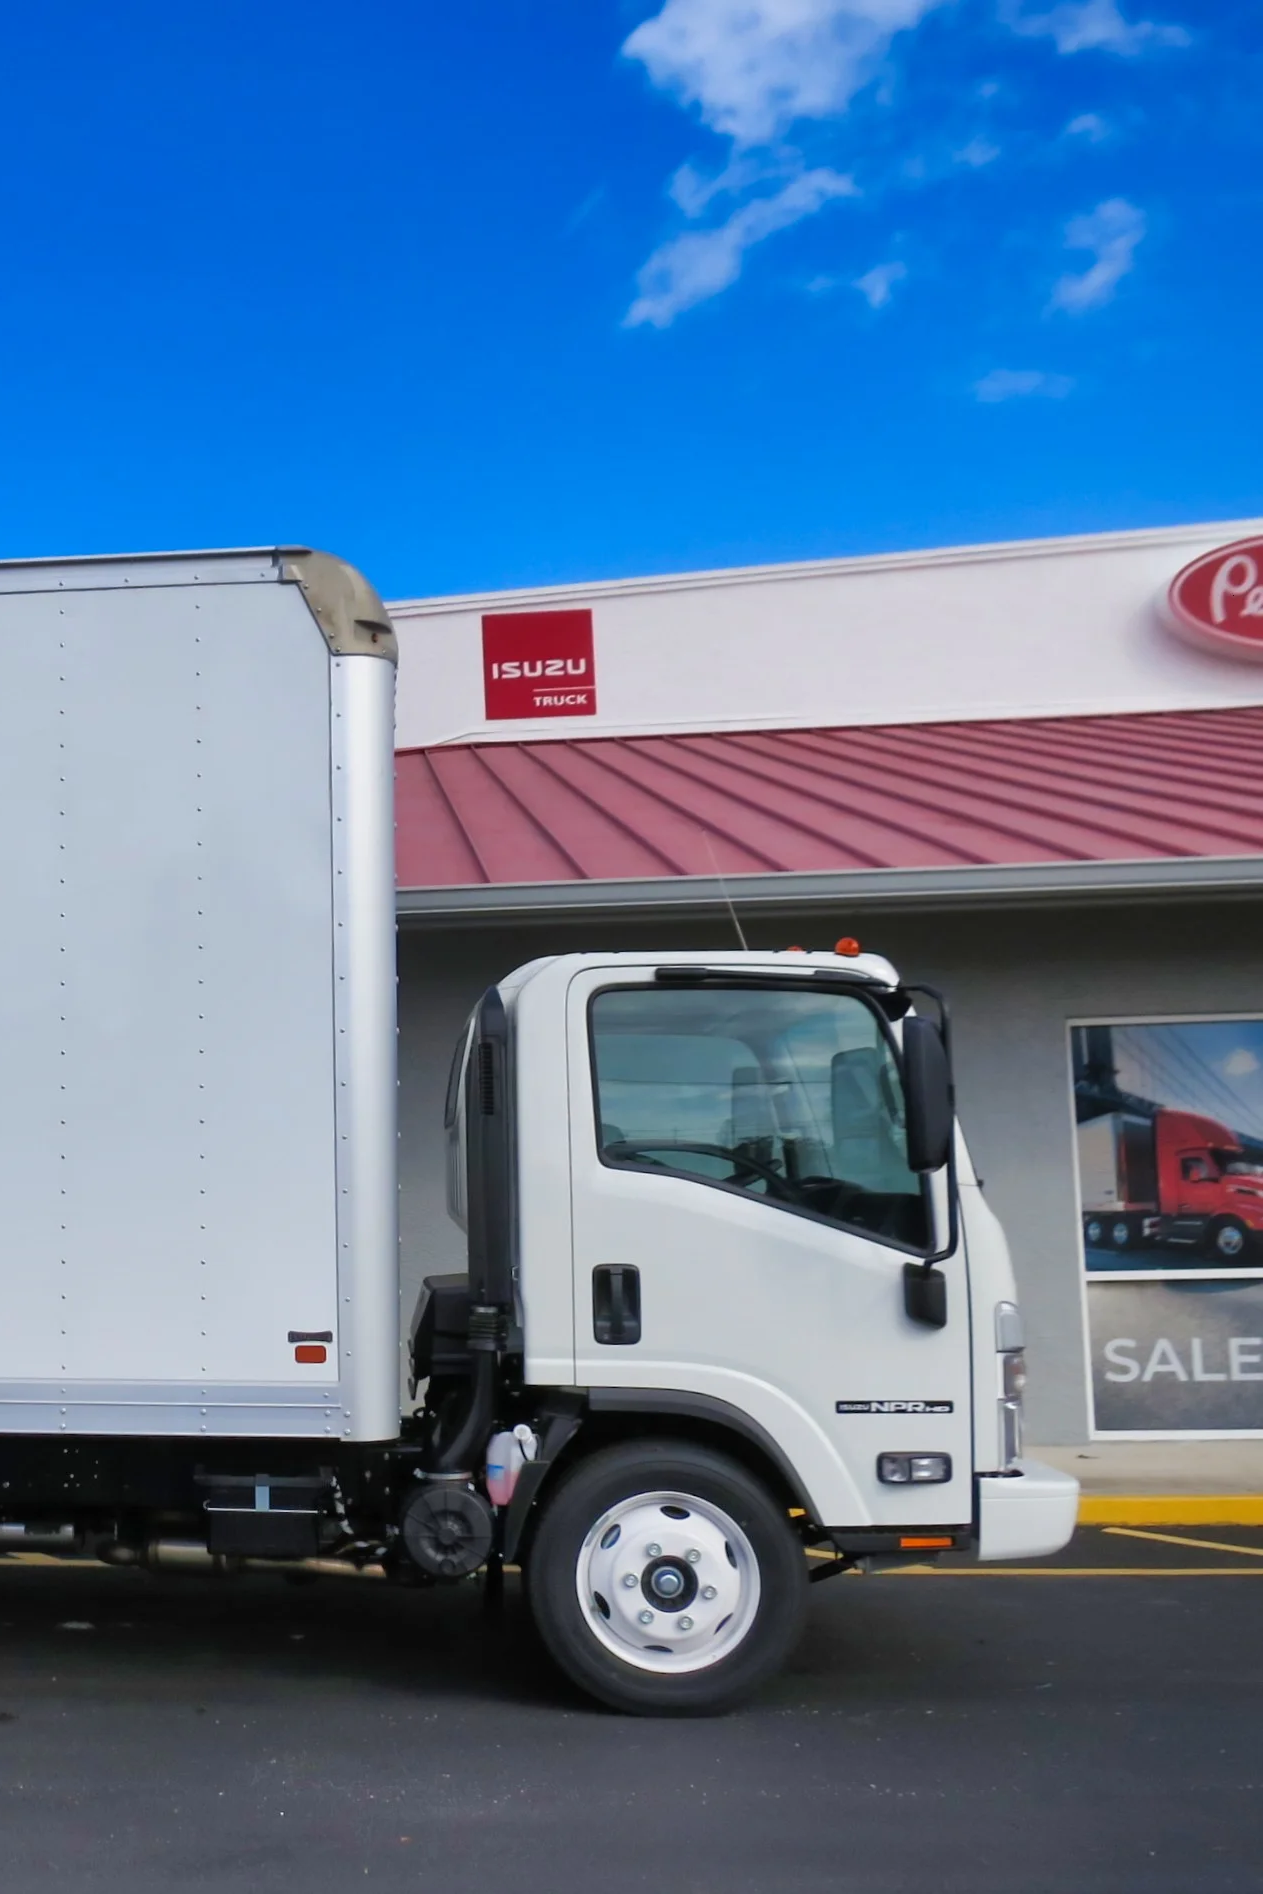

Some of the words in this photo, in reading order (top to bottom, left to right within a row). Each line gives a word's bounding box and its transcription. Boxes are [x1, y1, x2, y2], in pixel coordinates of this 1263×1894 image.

[492, 658, 586, 679] ISUZU
[533, 694, 587, 707] TRUCK
[1104, 1337, 1263, 1382] SALE
